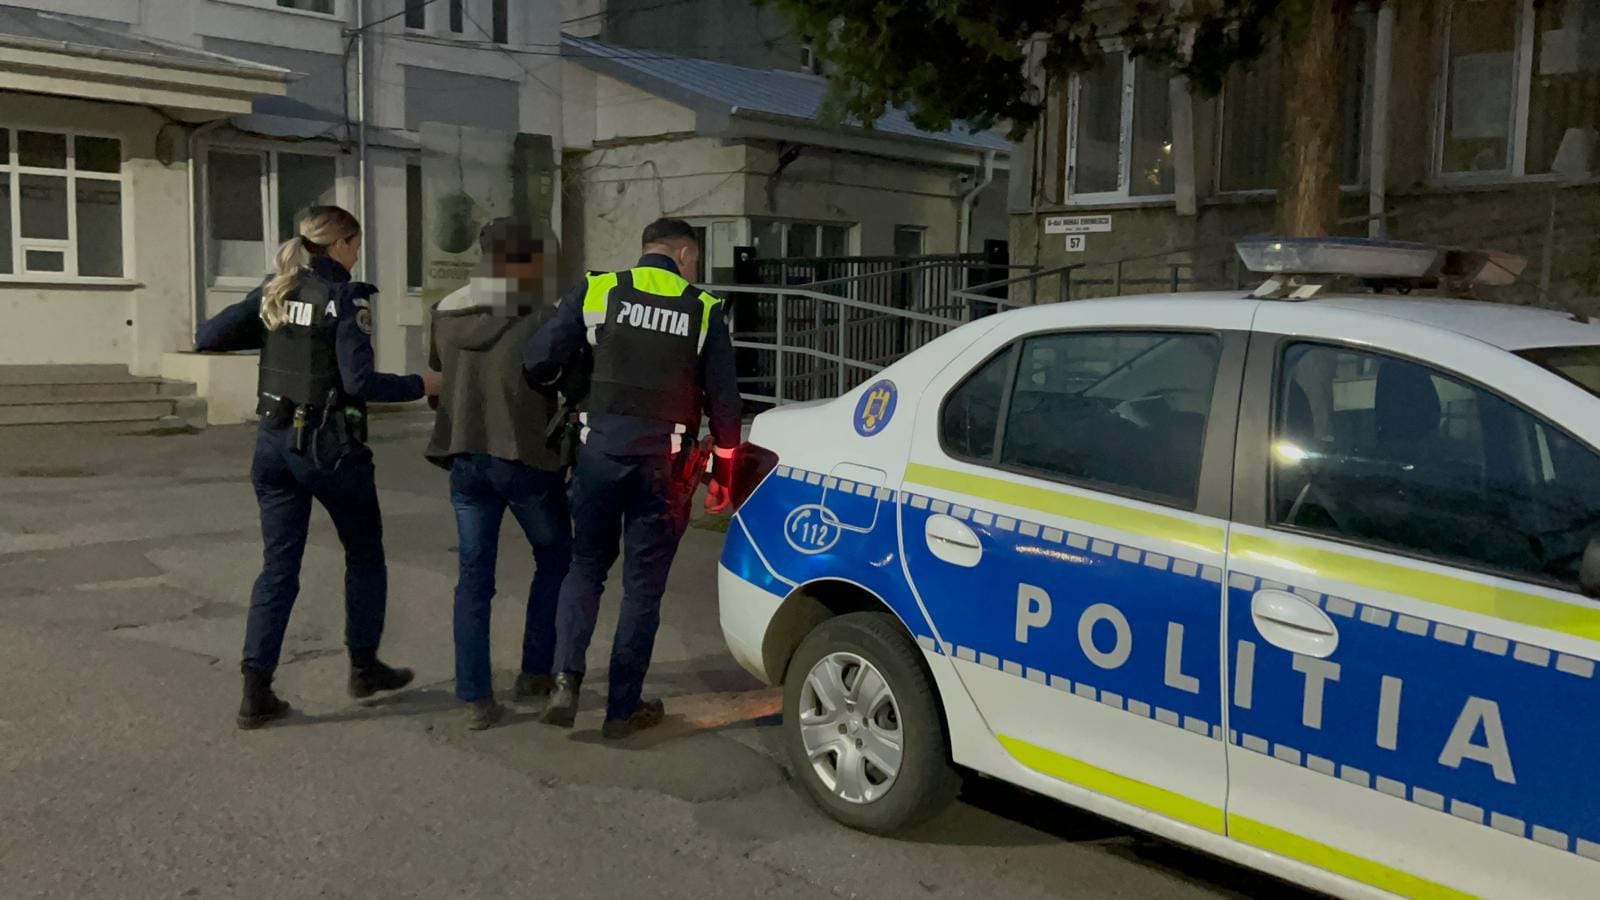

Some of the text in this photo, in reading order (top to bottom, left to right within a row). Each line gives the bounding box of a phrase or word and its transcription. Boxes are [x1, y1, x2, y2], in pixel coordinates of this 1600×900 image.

[1070, 237, 1081, 249] 57
[617, 301, 690, 336] POLITIA
[803, 522, 829, 546] 112
[1015, 582, 1516, 785] POLITIA
